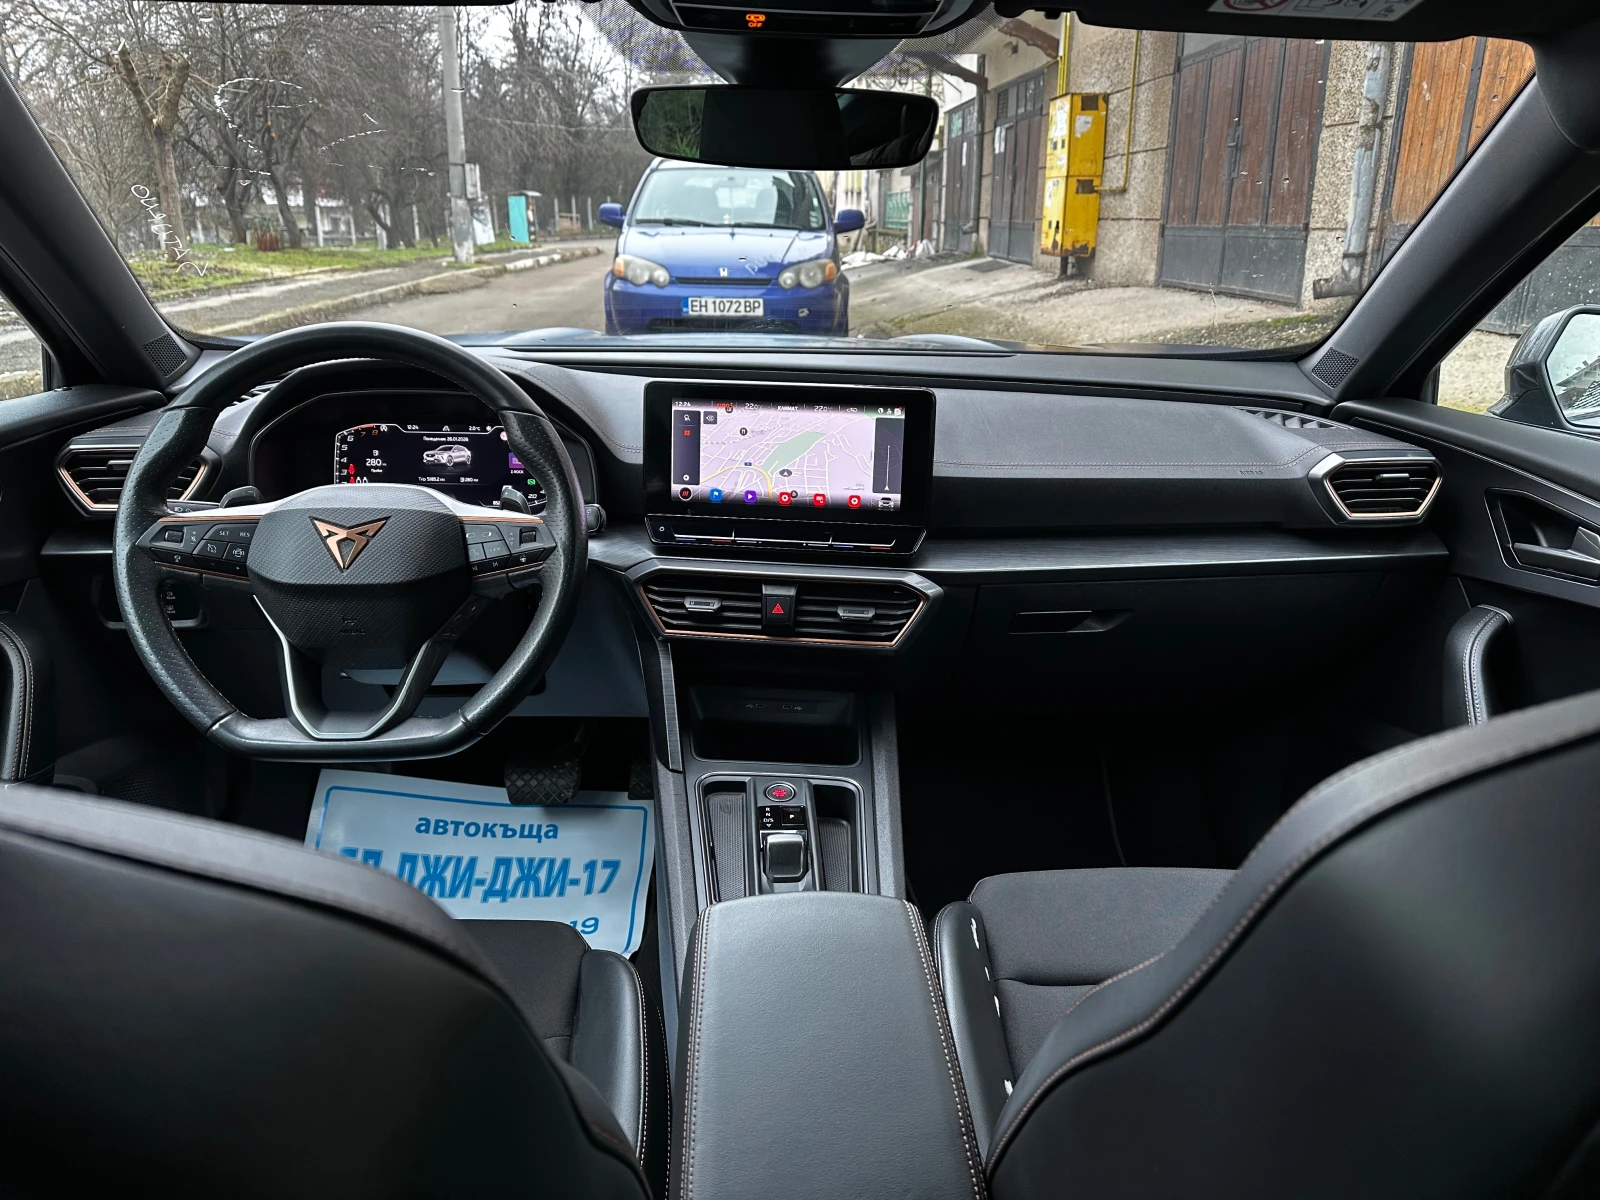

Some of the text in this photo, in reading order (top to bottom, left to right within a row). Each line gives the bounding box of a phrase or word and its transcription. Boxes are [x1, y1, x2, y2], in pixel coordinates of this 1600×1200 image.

[690, 299, 761, 313] EH 1072 BP
[365, 458, 382, 467] 280
[414, 816, 560, 844] автокъща
